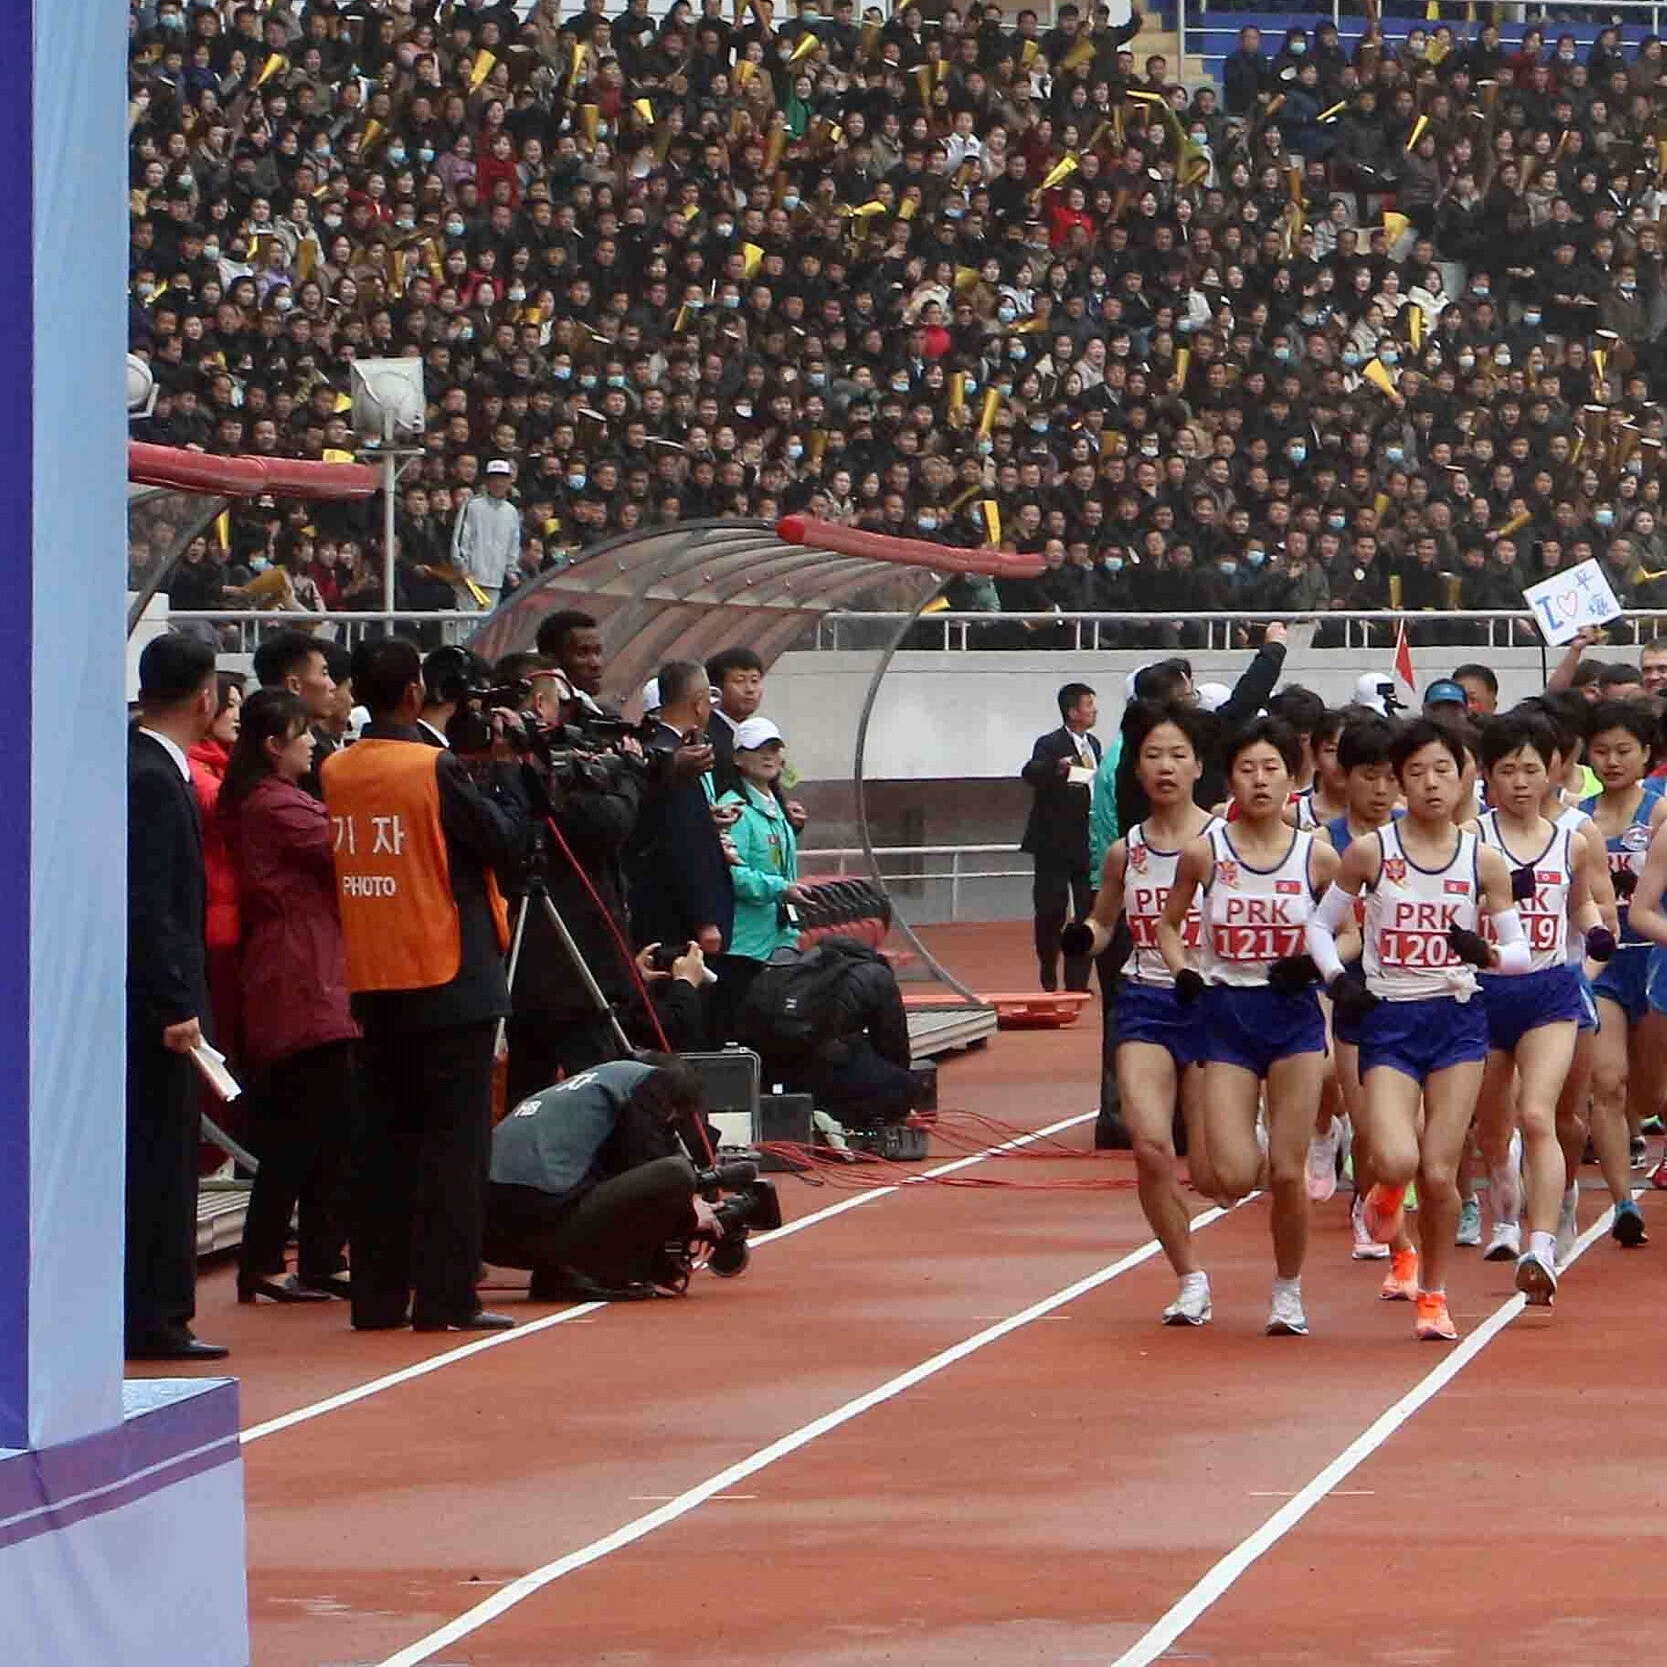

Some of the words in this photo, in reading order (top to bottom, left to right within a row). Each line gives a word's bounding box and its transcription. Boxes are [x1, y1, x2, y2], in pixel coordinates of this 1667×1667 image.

[343, 875, 396, 897] PHOTO
[1227, 898, 1290, 924] PRK
[1395, 902, 1463, 930] PRK
[1217, 928, 1302, 959] 1217
[1382, 933, 1462, 966] 120
